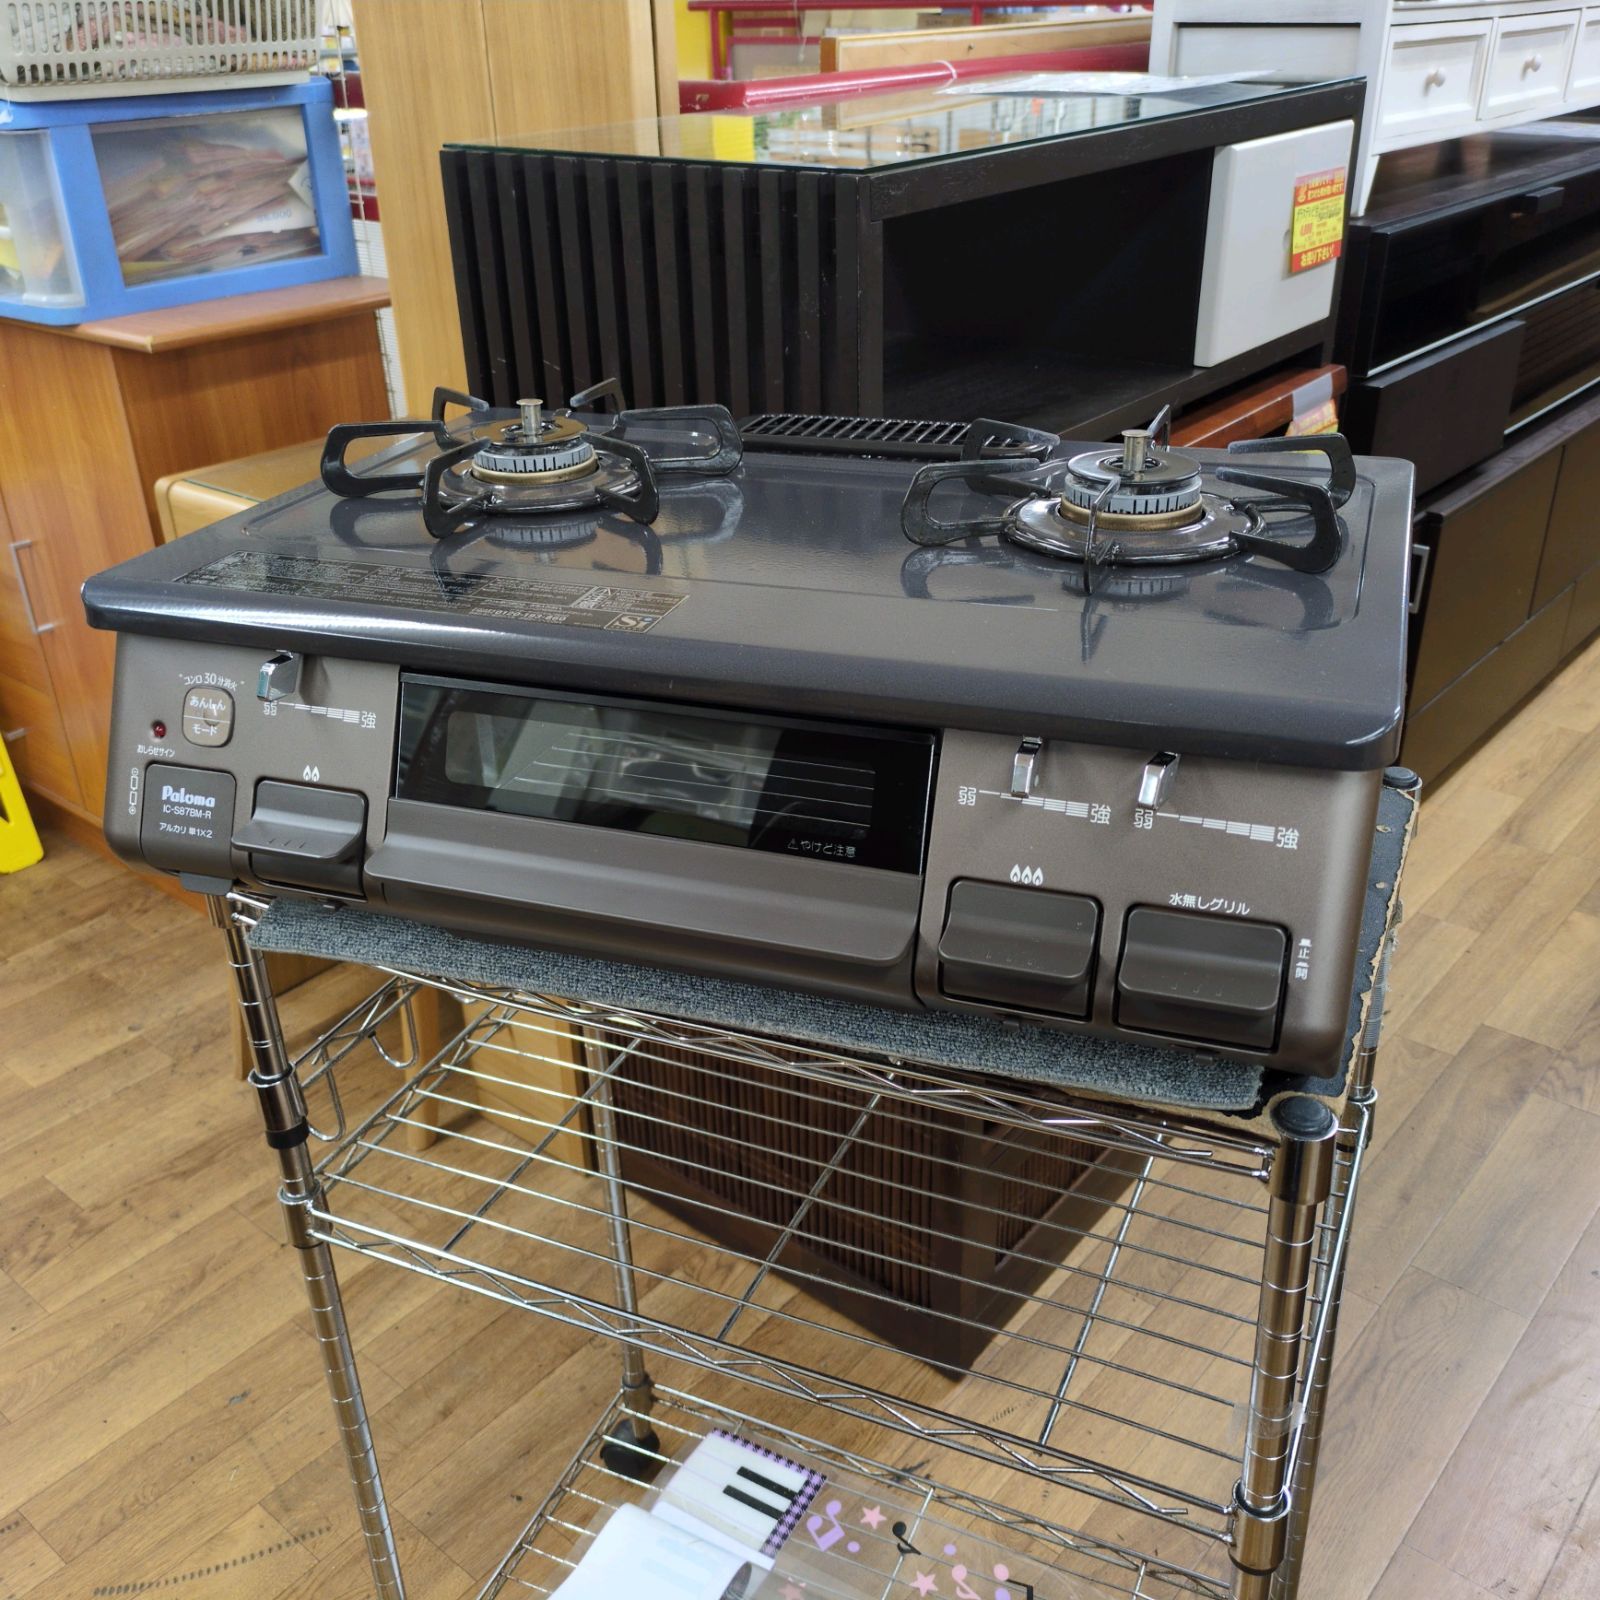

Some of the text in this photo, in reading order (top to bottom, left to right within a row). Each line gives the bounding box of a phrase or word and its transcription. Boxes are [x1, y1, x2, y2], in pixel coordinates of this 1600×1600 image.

[190, 696, 226, 712] あんしん
[361, 711, 377, 729] 強
[192, 723, 218, 736] モード
[137, 744, 175, 758] おしらせサイン
[162, 785, 216, 808] Paloma
[958, 786, 977, 806] 弱
[163, 804, 212, 820] IC-S87BM-R
[1091, 803, 1112, 825] 強
[1133, 808, 1154, 829] 弱
[159, 822, 187, 834] アルカリ
[1276, 827, 1300, 850] 強
[800, 840, 856, 858] やけど注意
[1169, 892, 1251, 916] 水無しグリル
